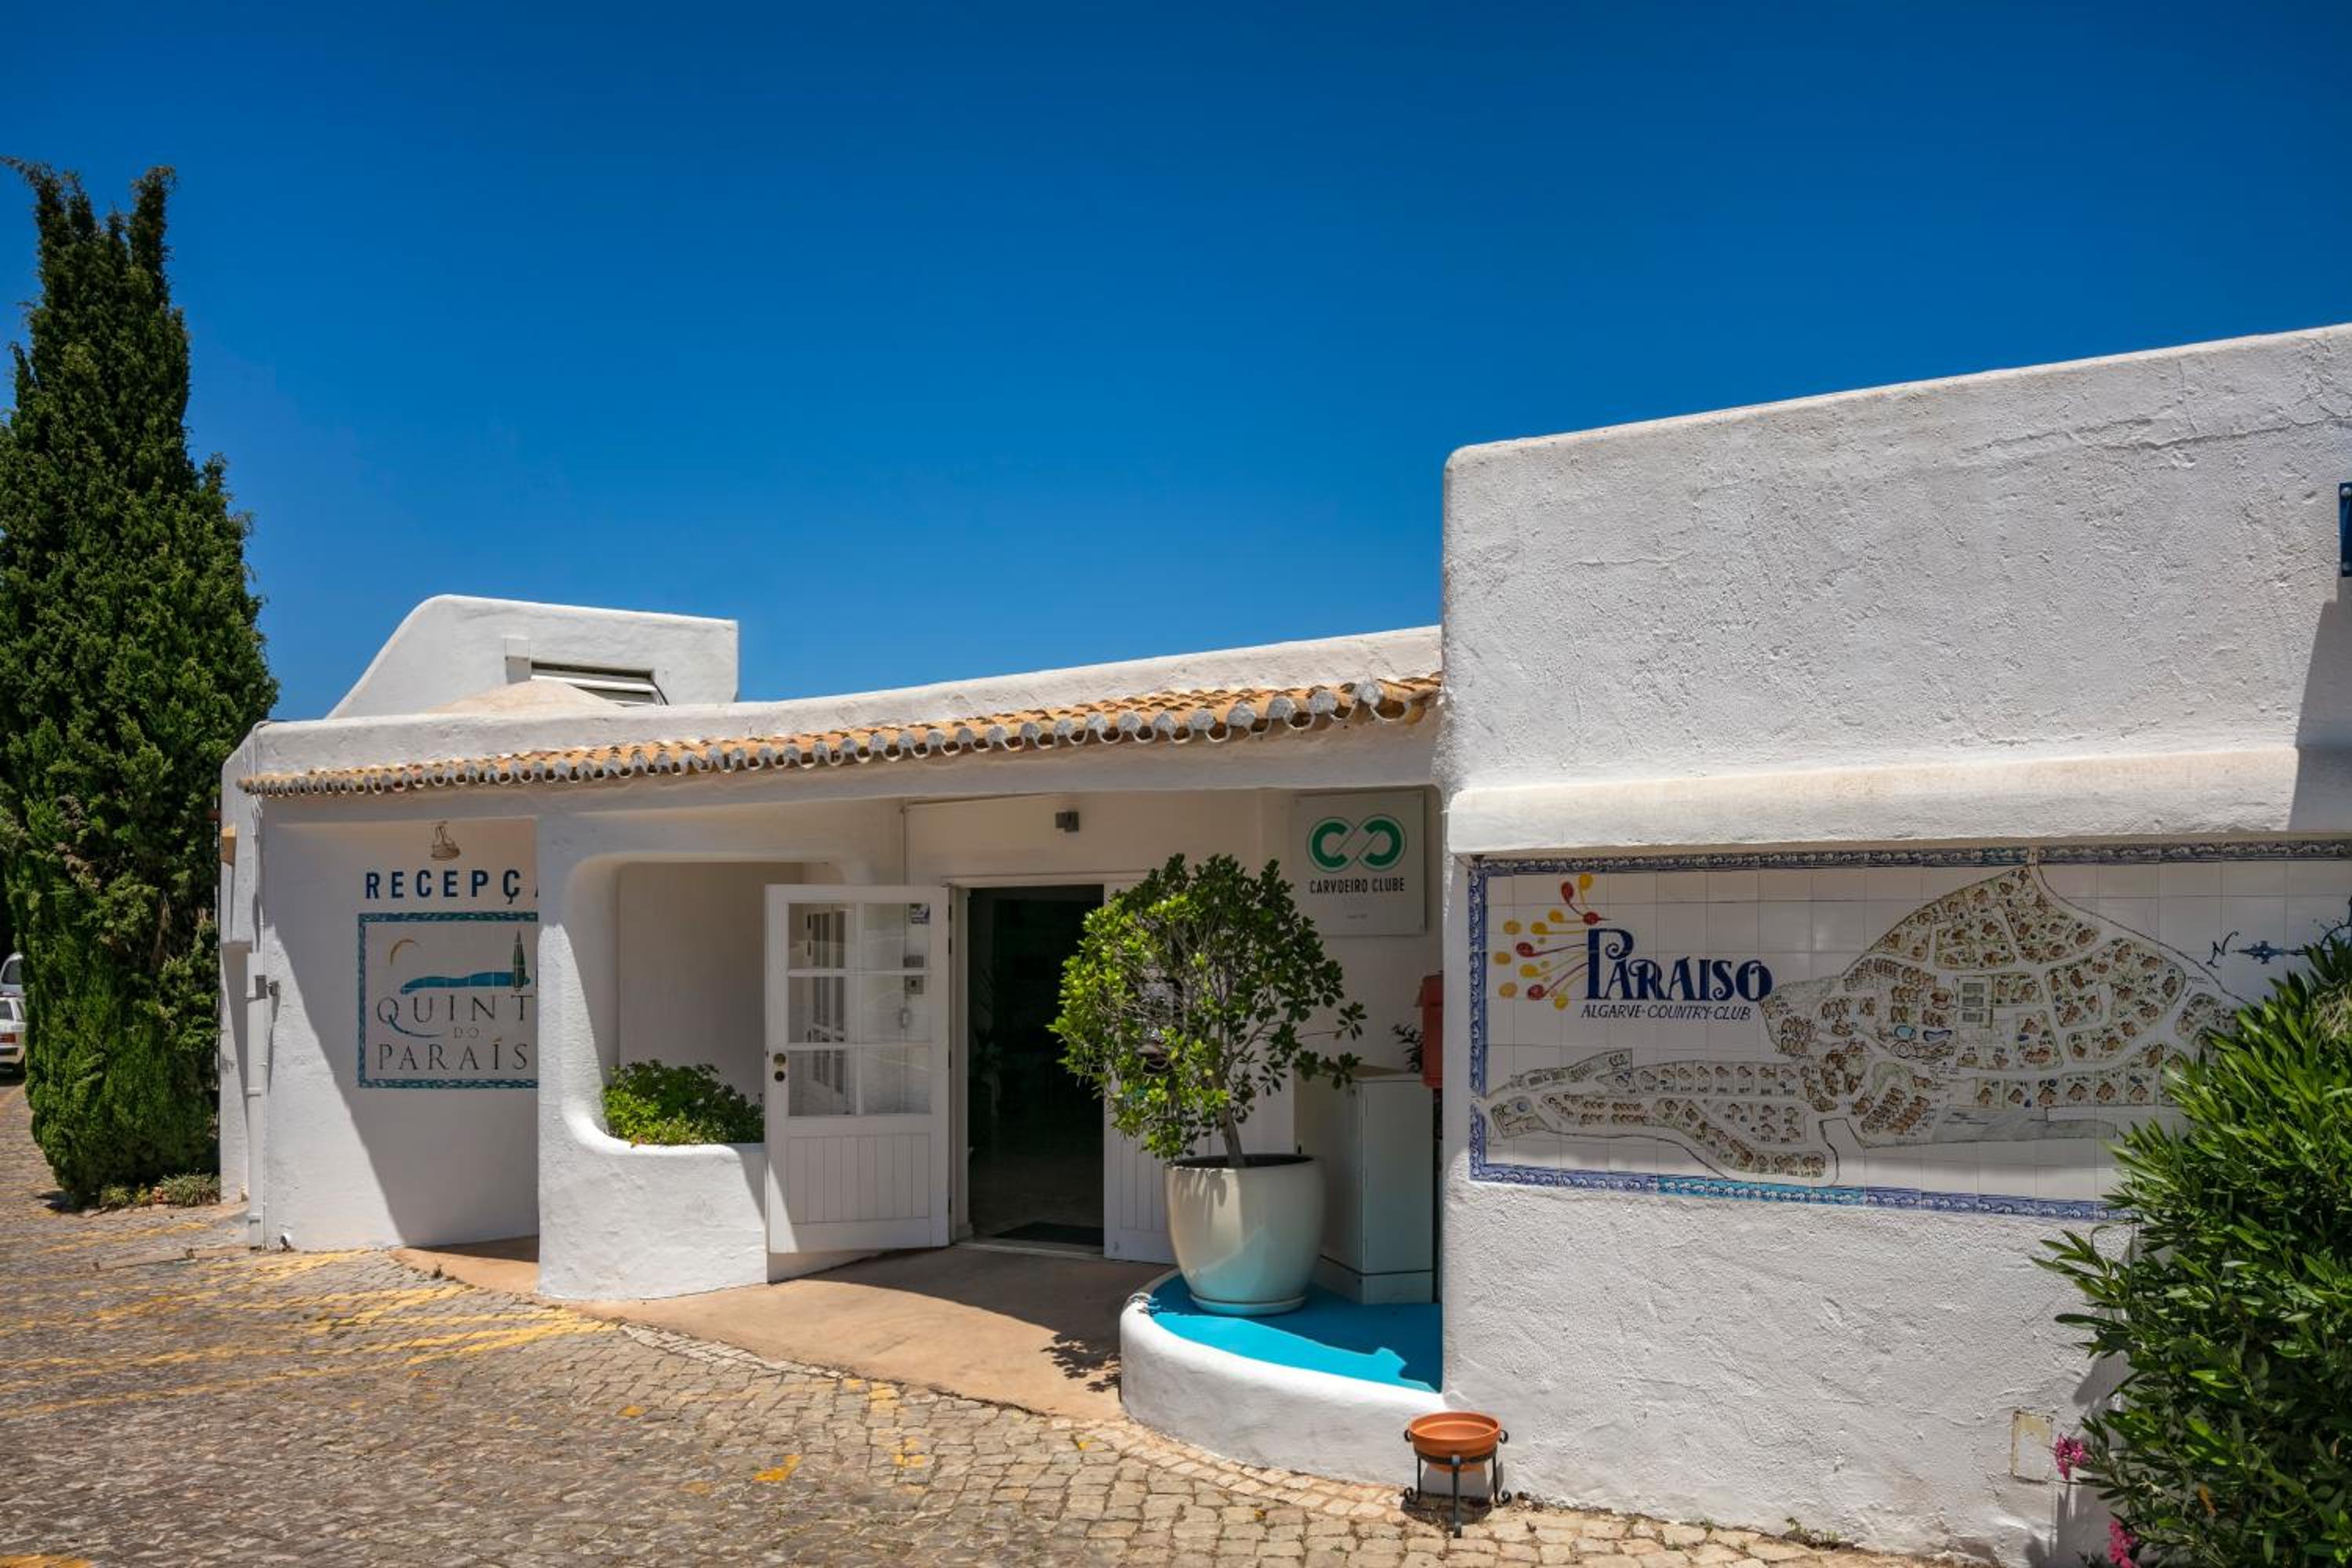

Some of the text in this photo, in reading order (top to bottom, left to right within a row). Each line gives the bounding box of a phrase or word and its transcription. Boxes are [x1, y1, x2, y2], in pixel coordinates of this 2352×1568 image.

[365, 869, 539, 905] RECEPÇ
[1372, 877, 1405, 891] CLUBE
[376, 995, 535, 1036] QUINT
[454, 1027, 480, 1039] DO
[378, 1037, 529, 1070] PARAÍS
